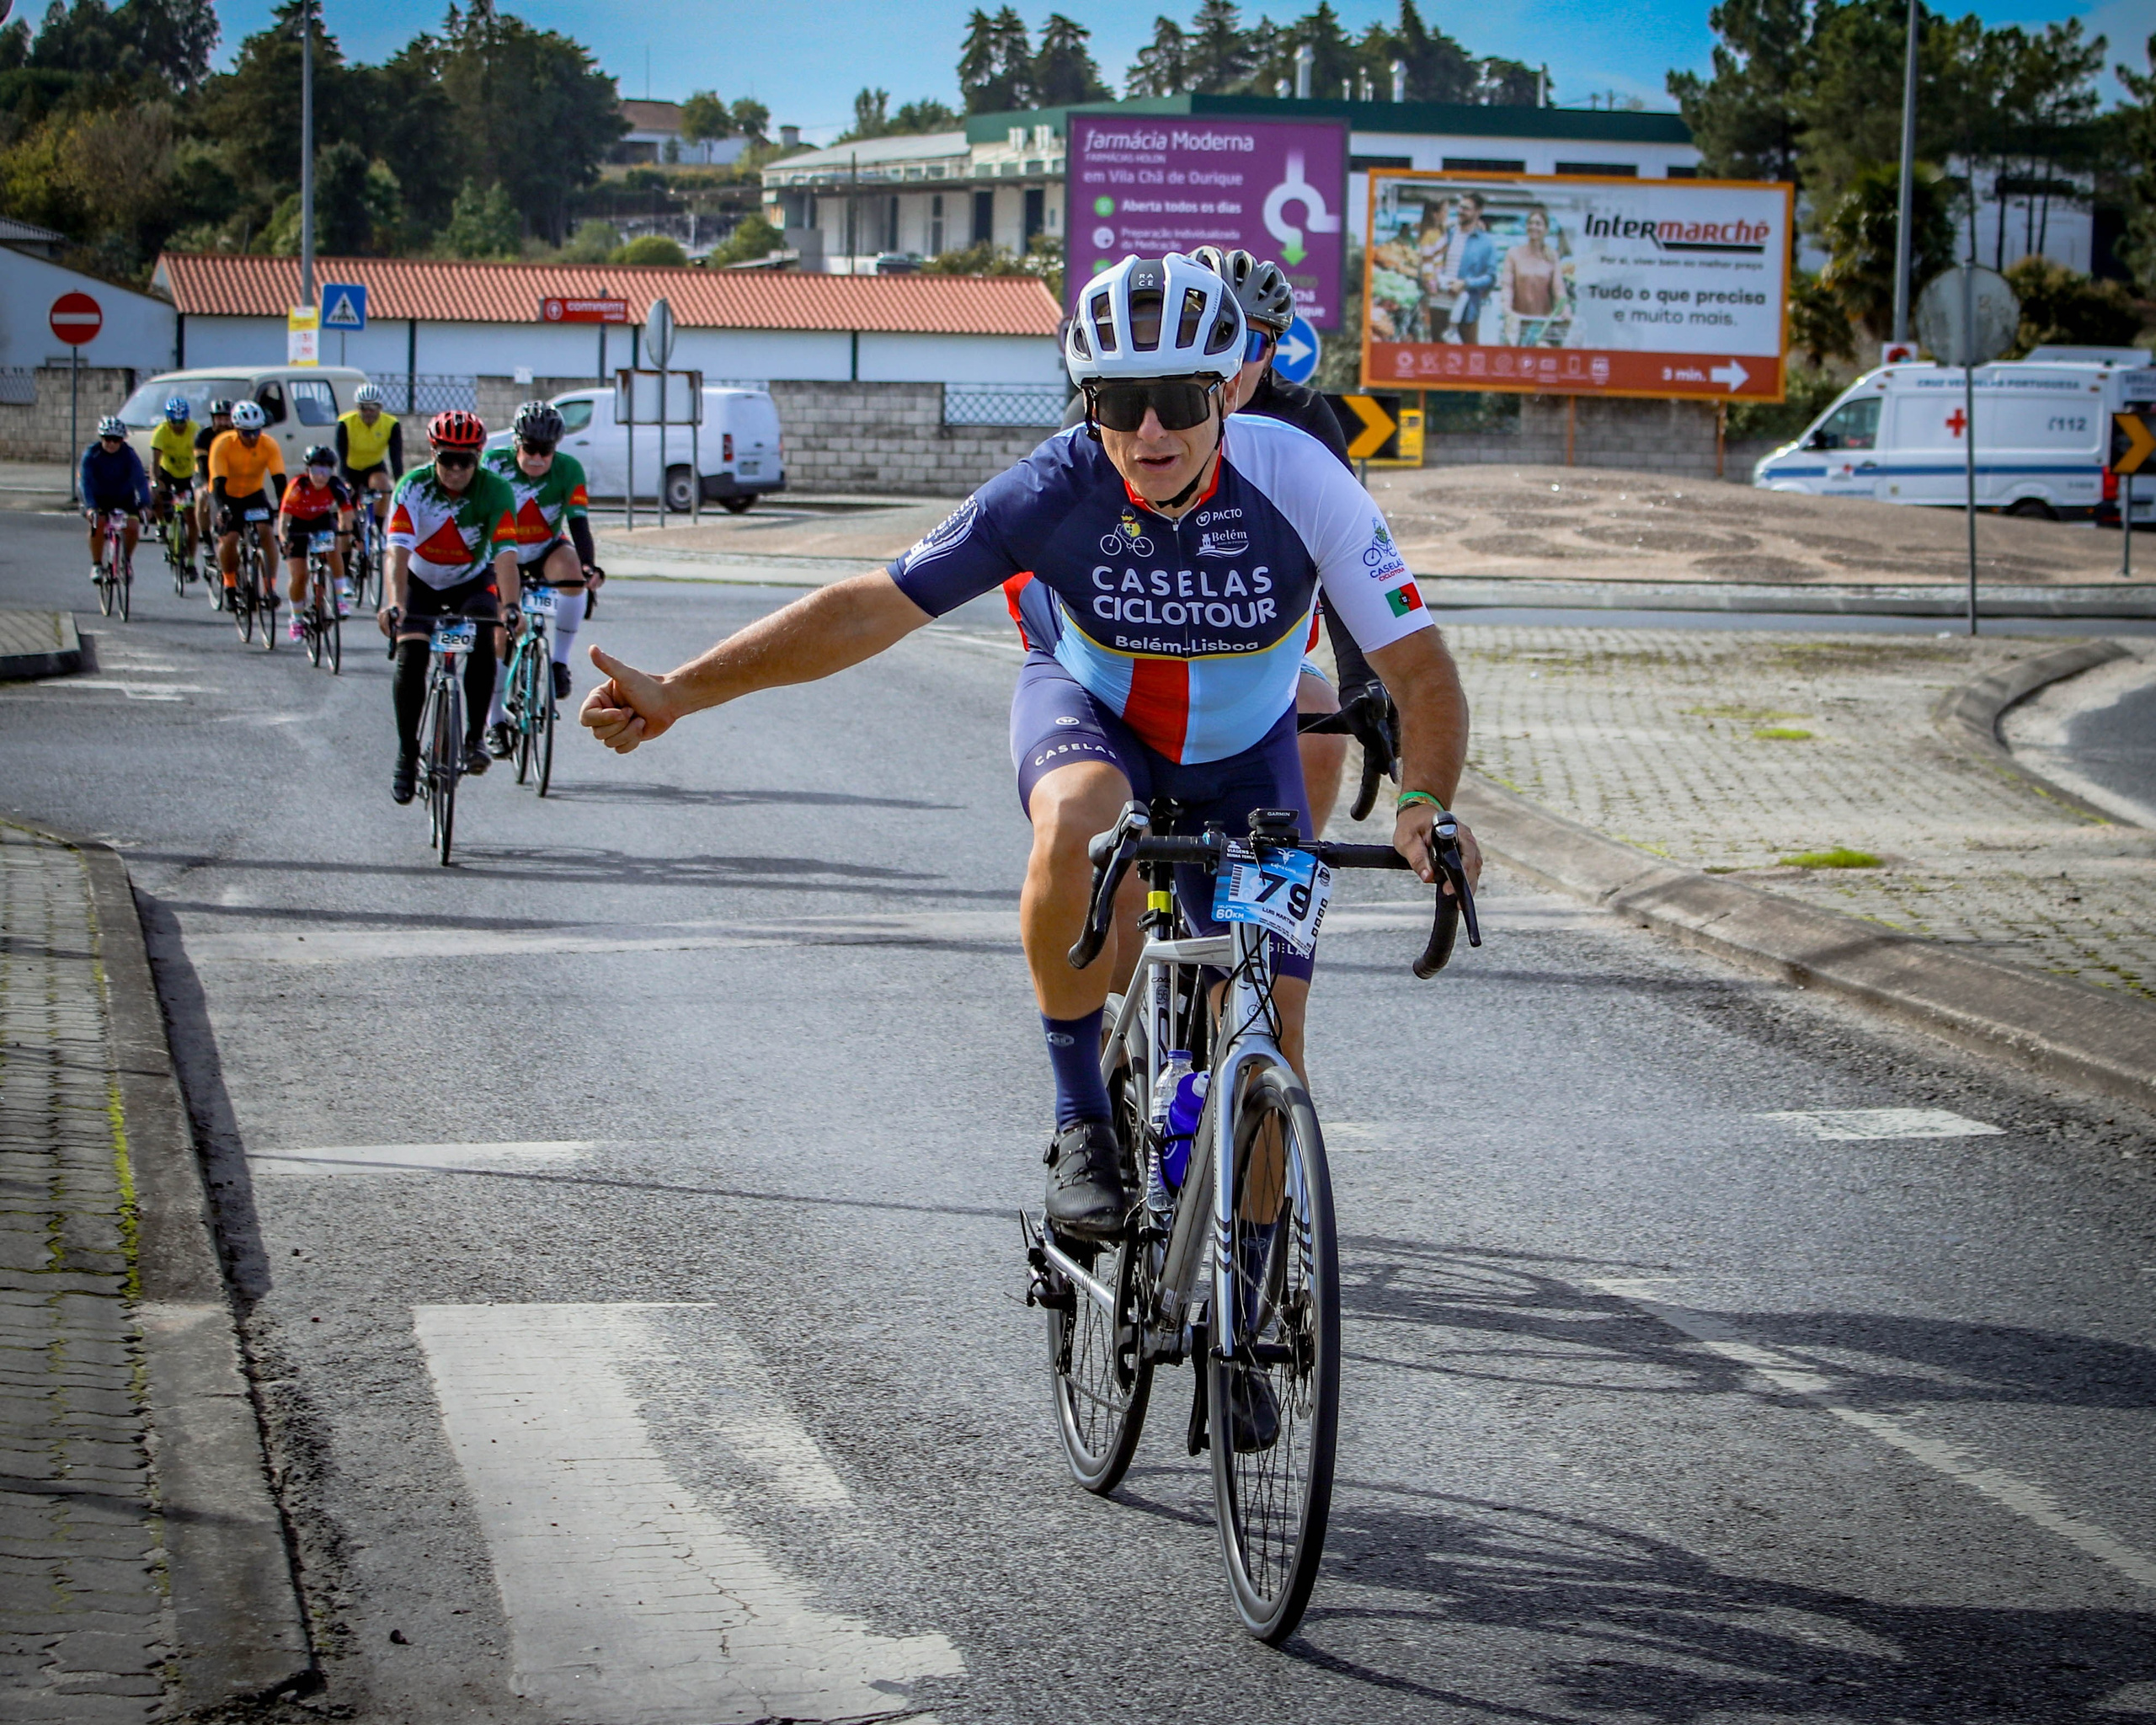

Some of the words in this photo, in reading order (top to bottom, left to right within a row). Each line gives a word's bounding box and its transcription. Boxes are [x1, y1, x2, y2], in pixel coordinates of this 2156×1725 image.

[1084, 129, 1167, 152] farmácia
[1171, 131, 1254, 152] Moderna
[1084, 172, 1105, 183] em
[1109, 170, 1134, 184] Vila
[1139, 170, 1164, 184] Chã
[1167, 171, 1185, 184] de
[1188, 171, 1243, 187] Ourique
[1123, 200, 1162, 212] Aberta
[1165, 200, 1198, 213] todos
[1201, 203, 1214, 213] os
[1217, 201, 1241, 214] dias
[1588, 285, 1634, 300] Tudo
[1640, 290, 1651, 301] o
[1657, 290, 1690, 305] que
[1696, 288, 1766, 306] precisa
[1614, 310, 1625, 322] e
[1631, 309, 1684, 324] muito
[1689, 311, 1737, 327] mais.
[1213, 508, 1242, 521] PACTO
[1212, 529, 1248, 542] Belém
[1092, 565, 1273, 598] CASELAS
[1093, 595, 1278, 628] CICLOTOUR
[441, 633, 471, 646] 220
[1115, 635, 1258, 654] Belém-Lisboa
[1035, 742, 1117, 766] CASELAS
[1255, 870, 1311, 921] 79
